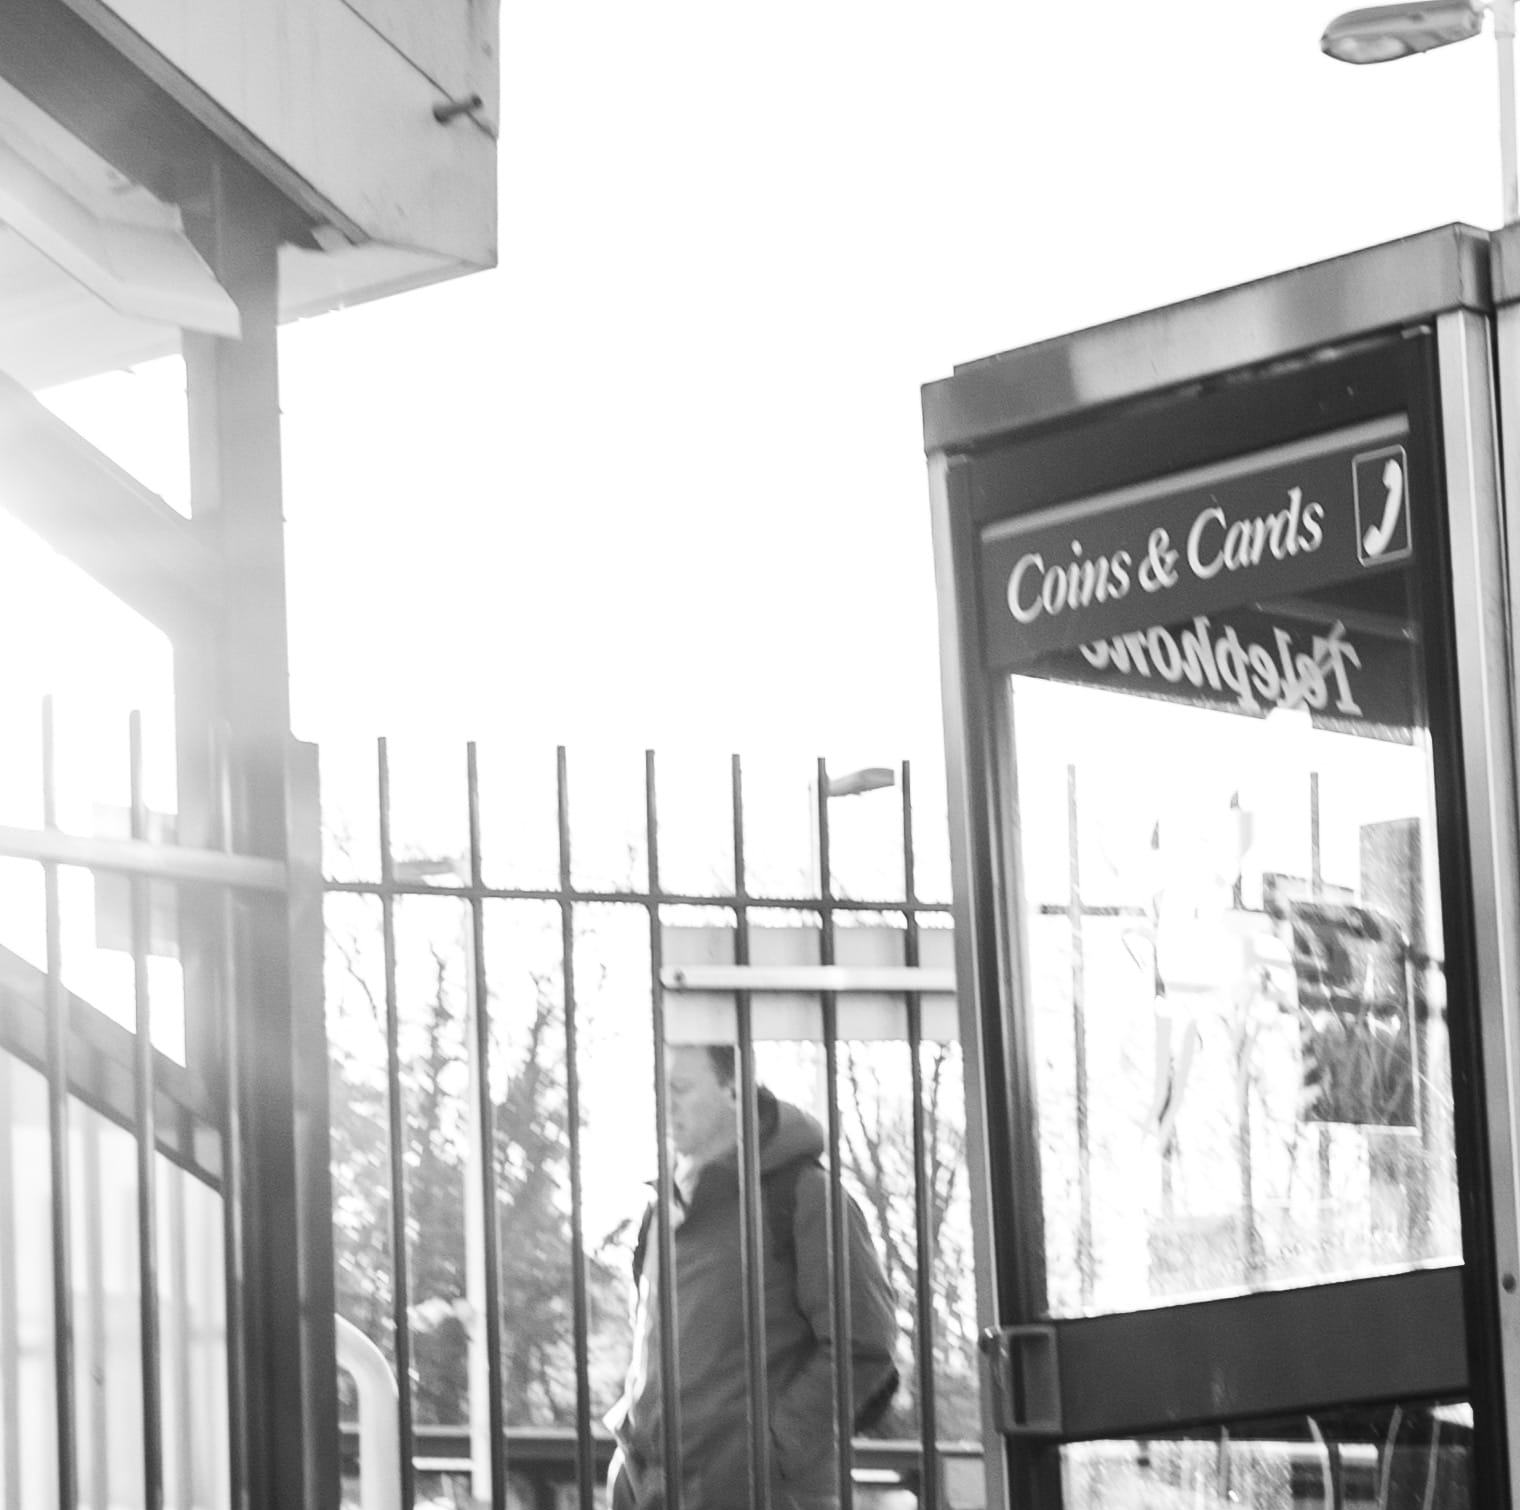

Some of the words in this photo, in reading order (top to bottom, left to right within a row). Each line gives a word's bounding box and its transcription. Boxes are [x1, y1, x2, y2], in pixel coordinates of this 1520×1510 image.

[1006, 540, 1132, 624] Coins
[1136, 527, 1181, 593] &
[1186, 486, 1325, 580] Cards
